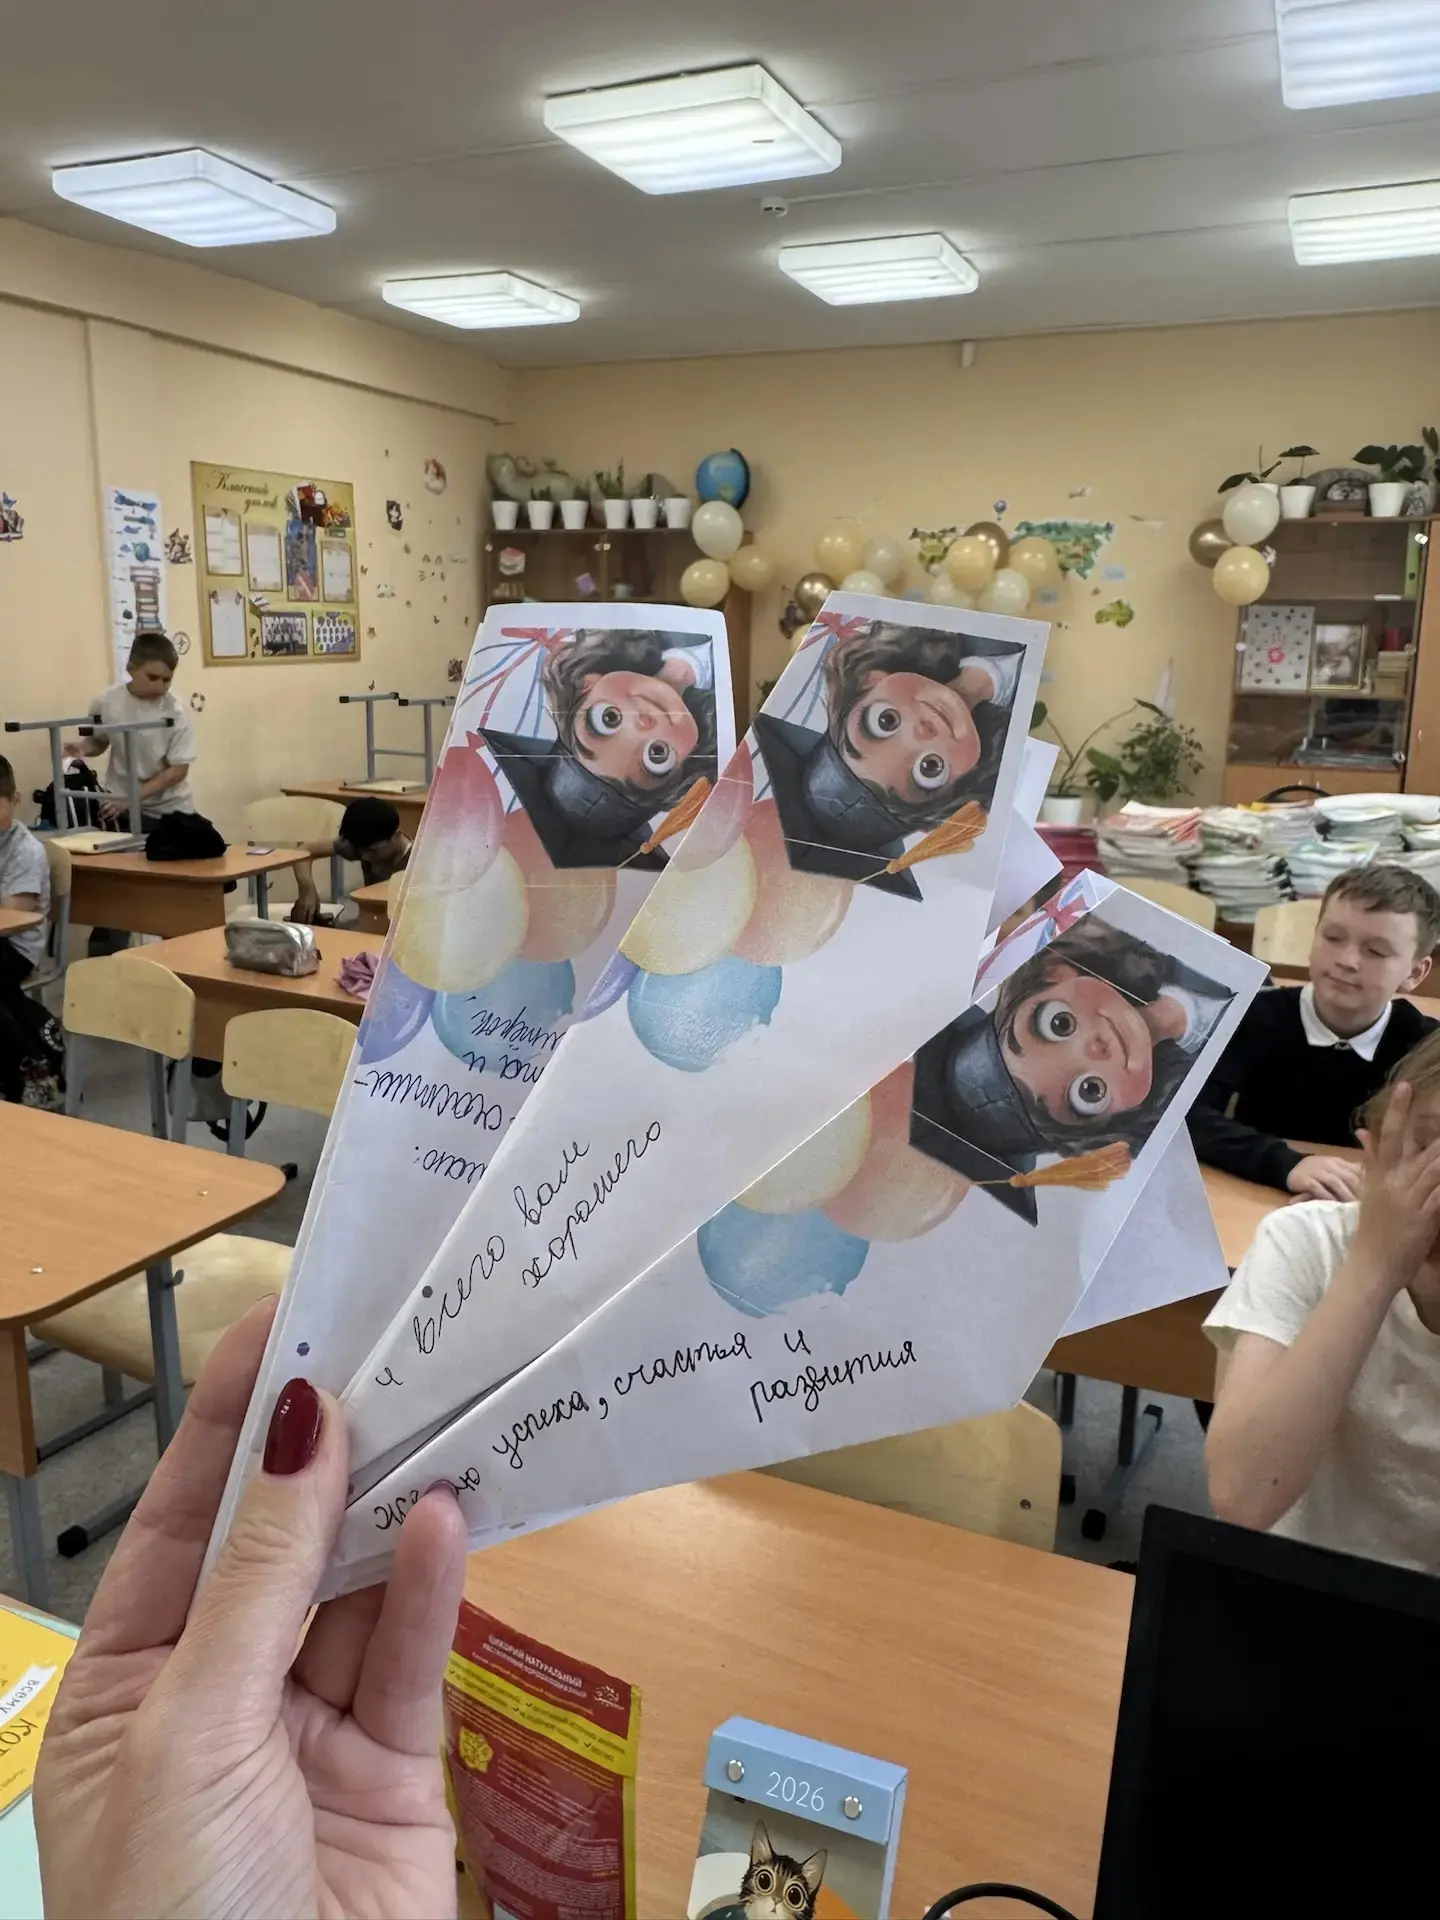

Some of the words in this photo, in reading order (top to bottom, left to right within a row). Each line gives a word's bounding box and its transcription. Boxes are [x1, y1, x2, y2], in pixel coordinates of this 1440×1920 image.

[521, 1121, 661, 1289] хорошего
[413, 1235, 506, 1355] всего
[613, 1331, 752, 1396] счастья
[783, 1328, 812, 1356] и
[749, 1340, 918, 1424] развития
[524, 1652, 583, 1689] НАТУРАЛЬНЫЙ
[766, 1771, 824, 1812] 2026
